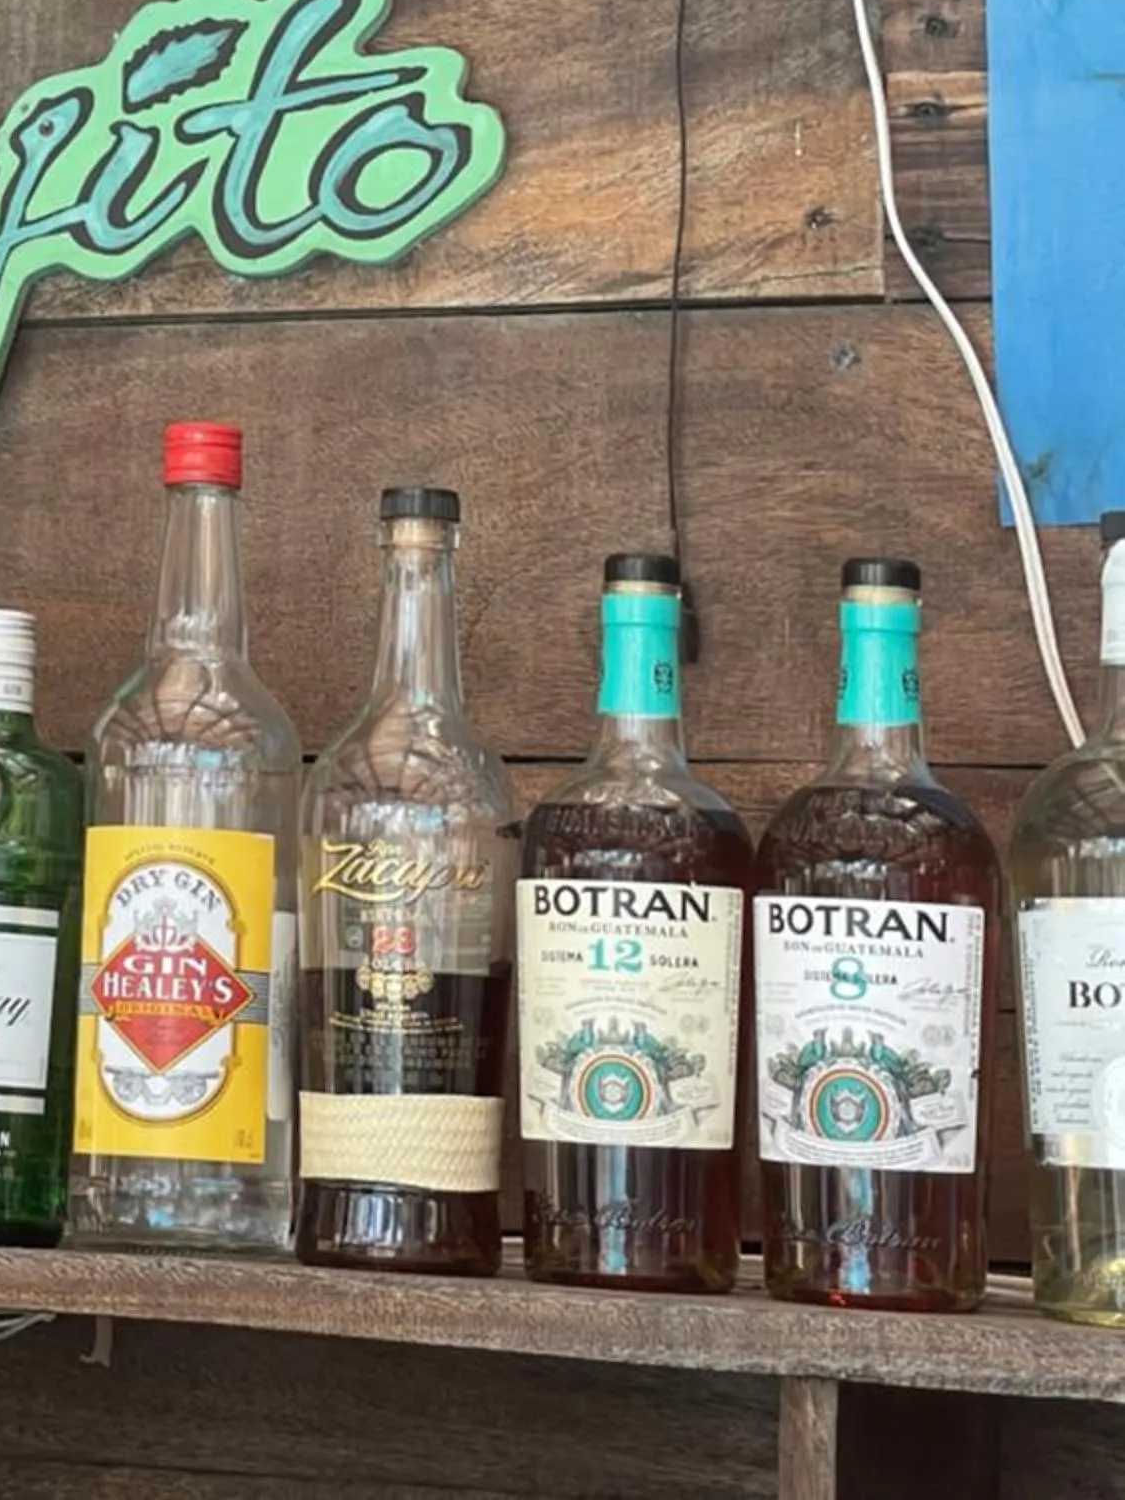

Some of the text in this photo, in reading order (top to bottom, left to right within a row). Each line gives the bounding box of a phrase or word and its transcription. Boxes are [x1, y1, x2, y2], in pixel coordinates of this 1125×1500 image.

[116, 867, 222, 913] DRY GIN
[533, 884, 711, 923] BOTRAN
[768, 902, 949, 944] BOTRAN
[122, 952, 208, 977] GIN
[587, 937, 644, 974] 12
[102, 970, 234, 1004] HEALEY'S
[829, 955, 868, 1001] 8
[1069, 980, 1125, 1009] BO
